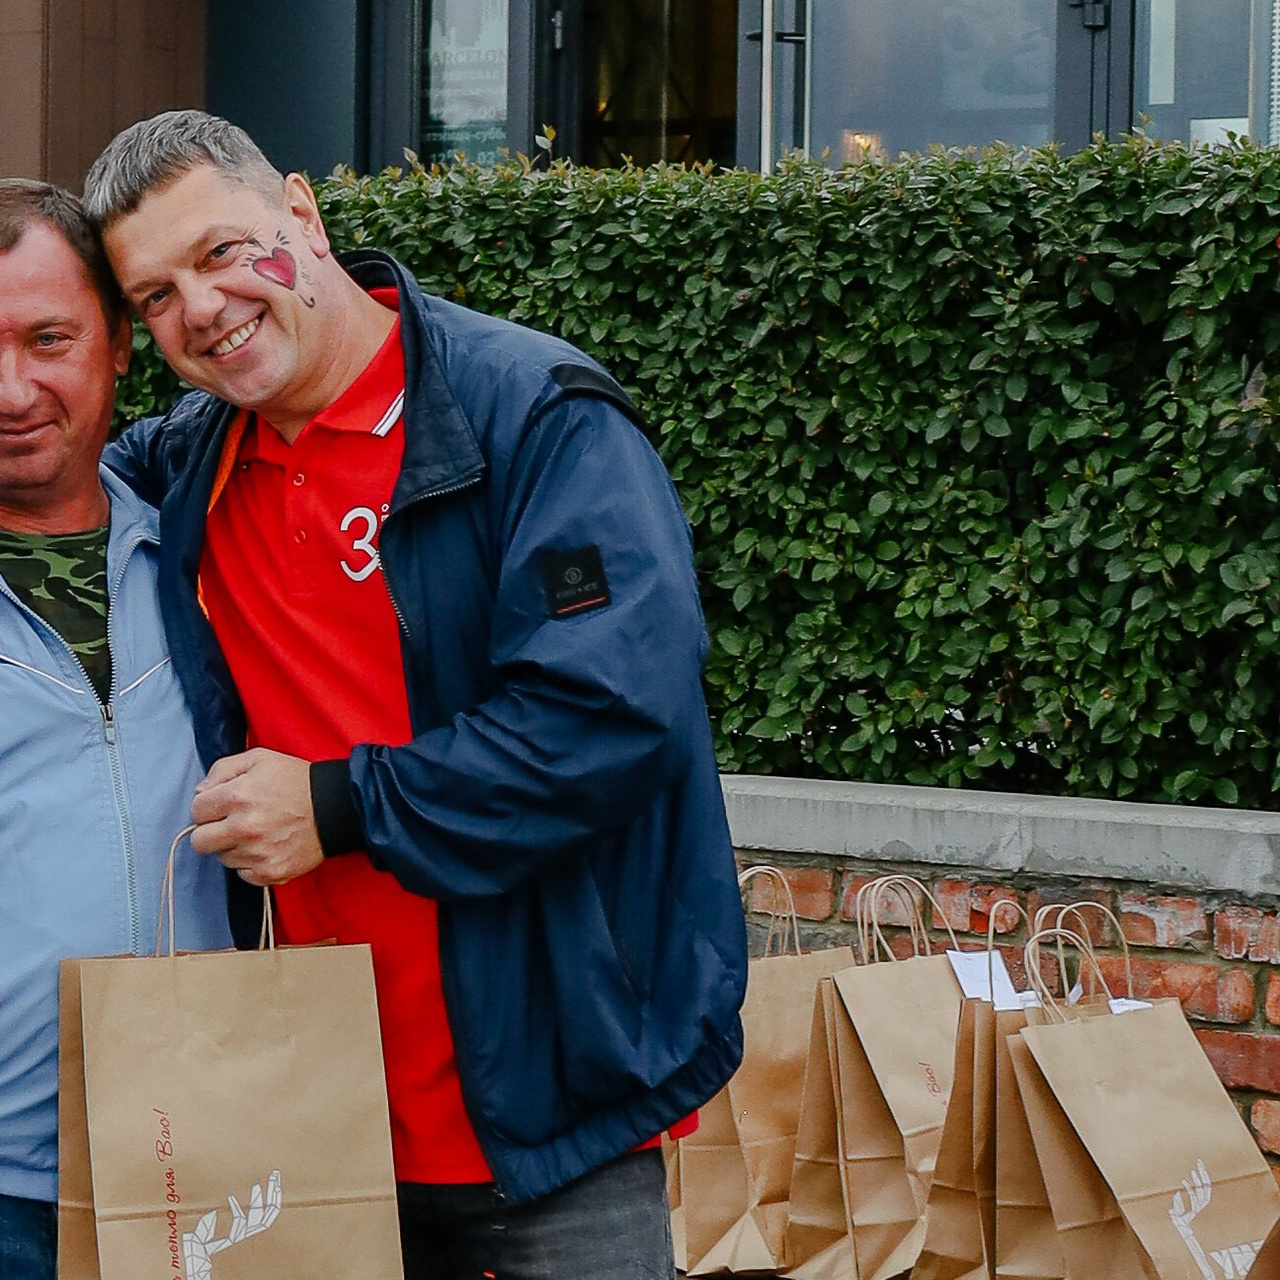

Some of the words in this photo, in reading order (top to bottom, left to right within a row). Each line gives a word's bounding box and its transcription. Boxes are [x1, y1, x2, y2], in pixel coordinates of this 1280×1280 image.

[152, 1107, 173, 1162] Вас!
[165, 1167, 180, 1204] для
[166, 1209, 180, 1269] тепло
